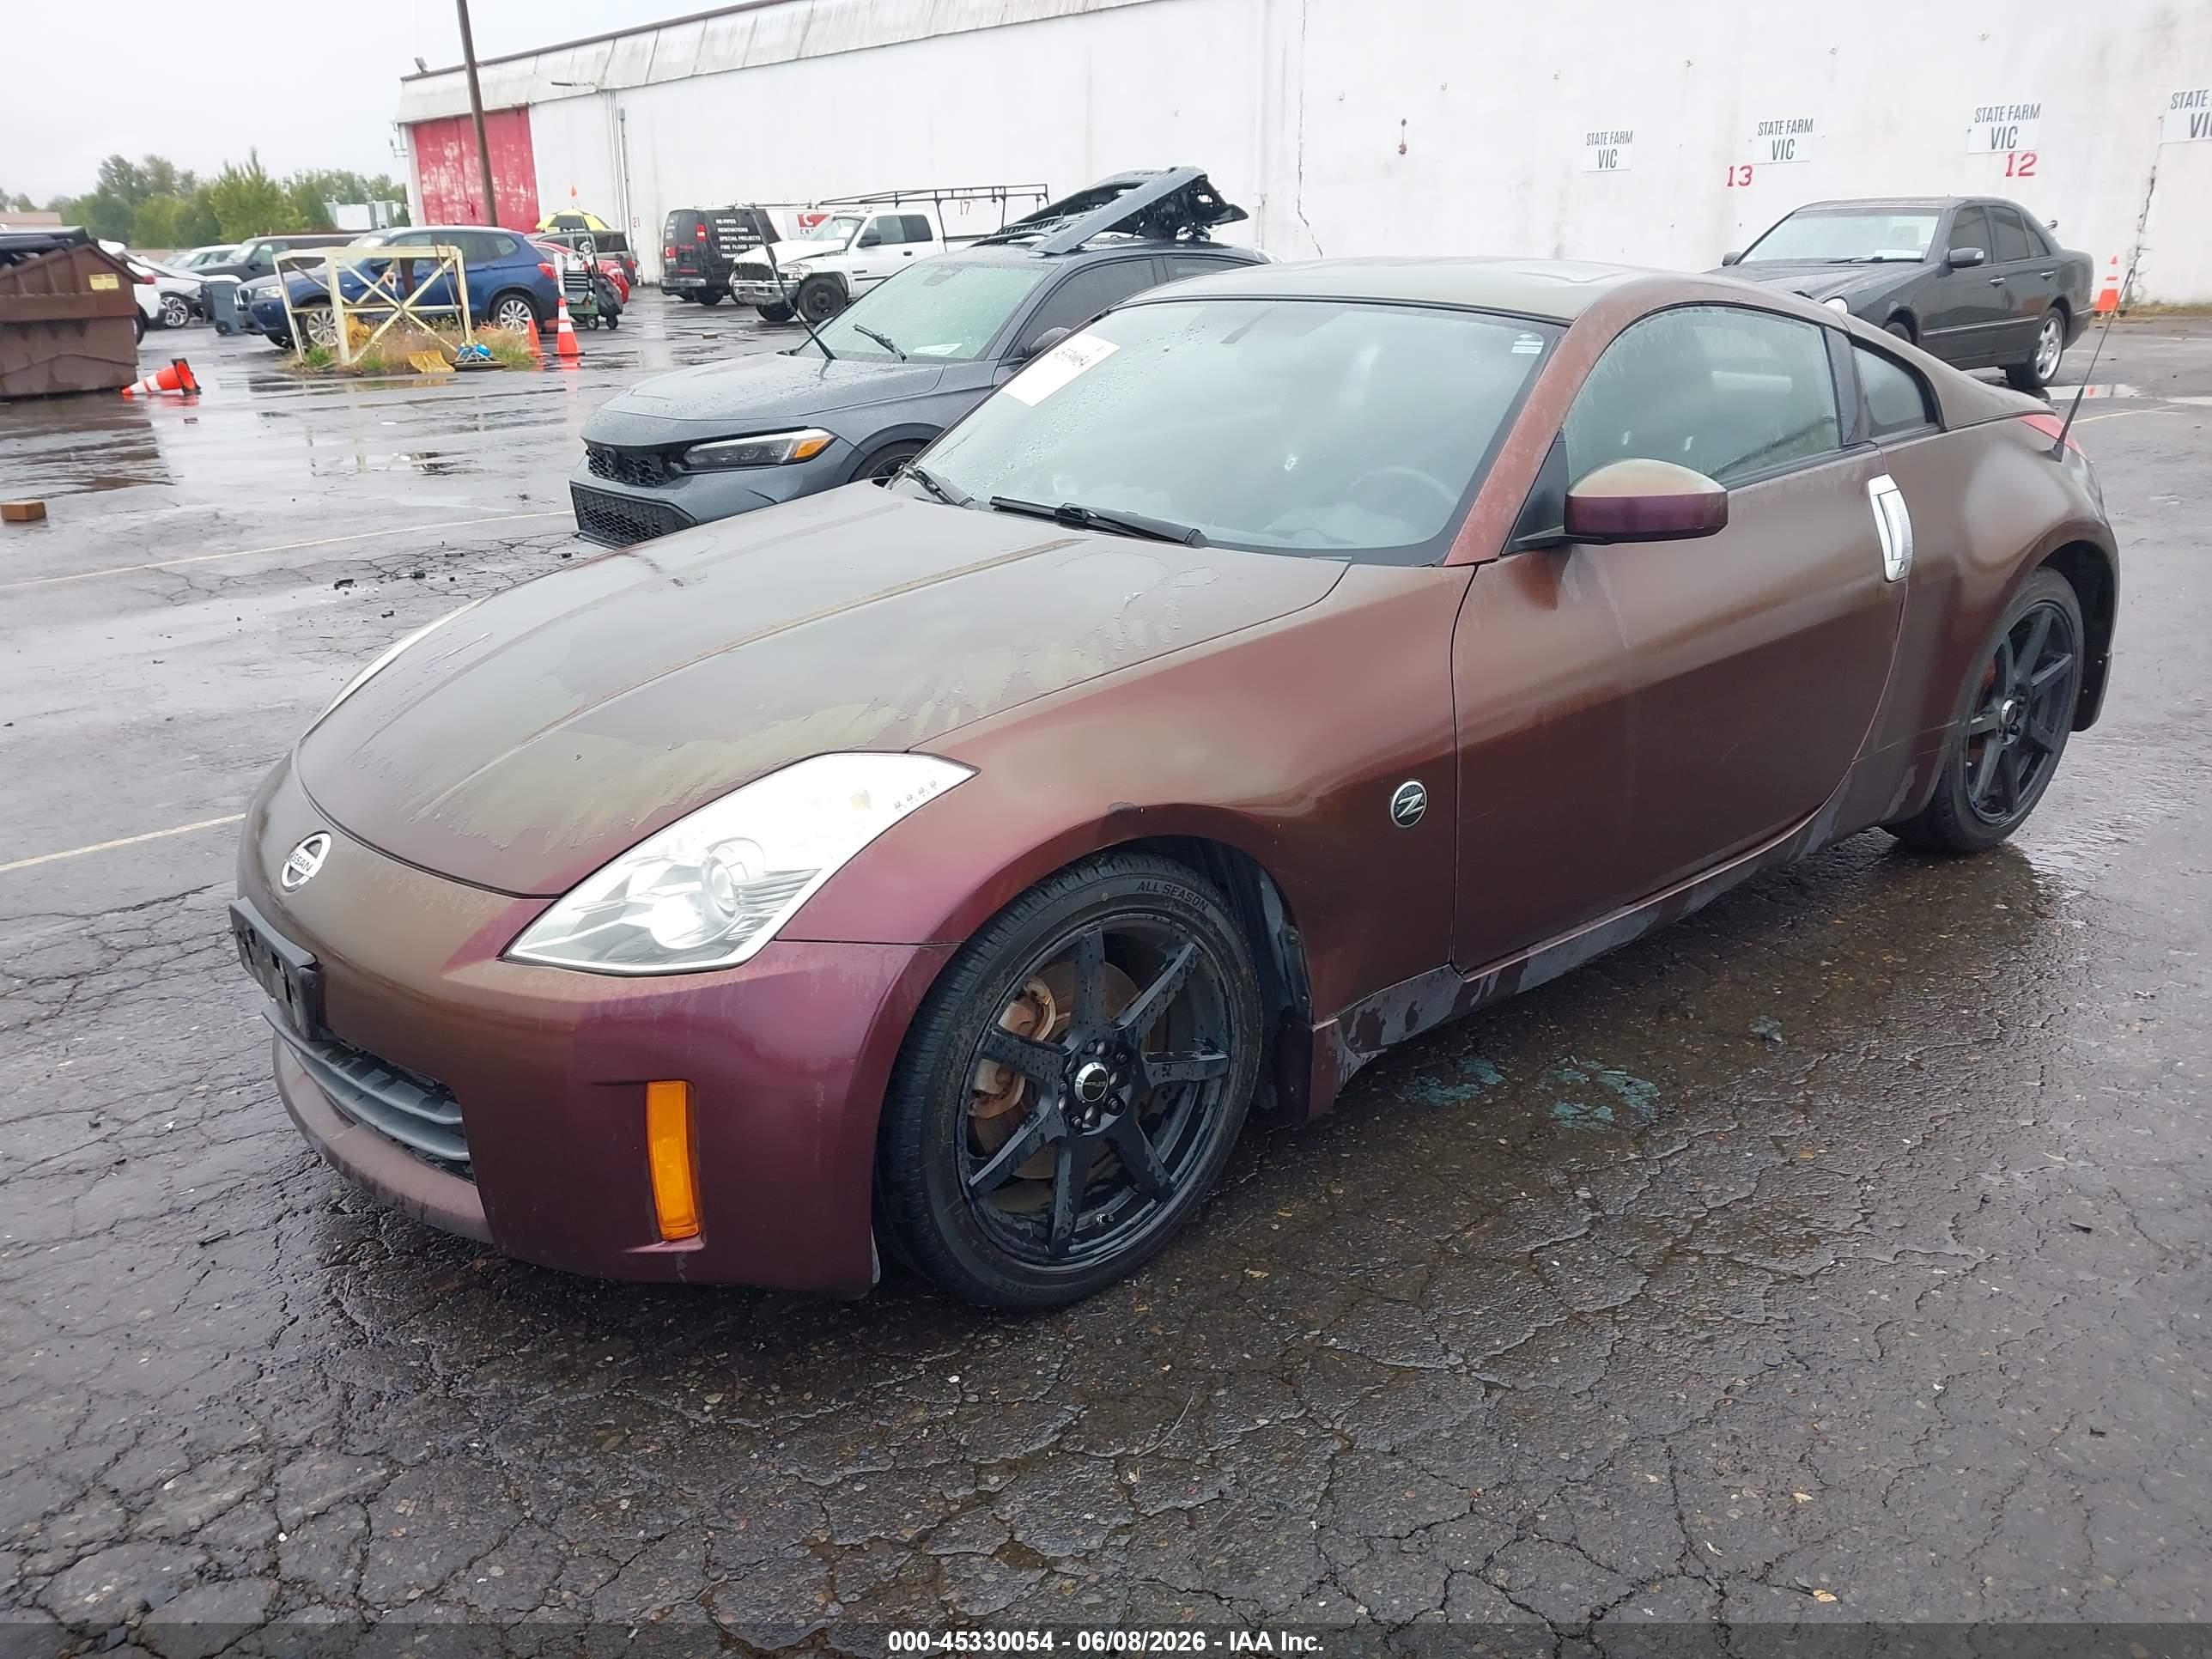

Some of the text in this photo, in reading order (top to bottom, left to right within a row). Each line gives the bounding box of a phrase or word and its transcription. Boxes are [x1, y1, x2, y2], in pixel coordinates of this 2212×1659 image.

[2170, 89, 2209, 110] STATE
[1975, 103, 2041, 123] STATE FARM
[1758, 118, 1814, 136] STATE FARM
[2191, 112, 2212, 138] VI
[1586, 131, 1633, 146] STATE FARM
[1991, 125, 2018, 149] VIC
[1598, 149, 1618, 168] VIC
[1771, 138, 1795, 161] VIC
[2005, 152, 2037, 177] 12
[1727, 165, 1753, 186] 13
[1136, 881, 1209, 911] ALL SEASON
